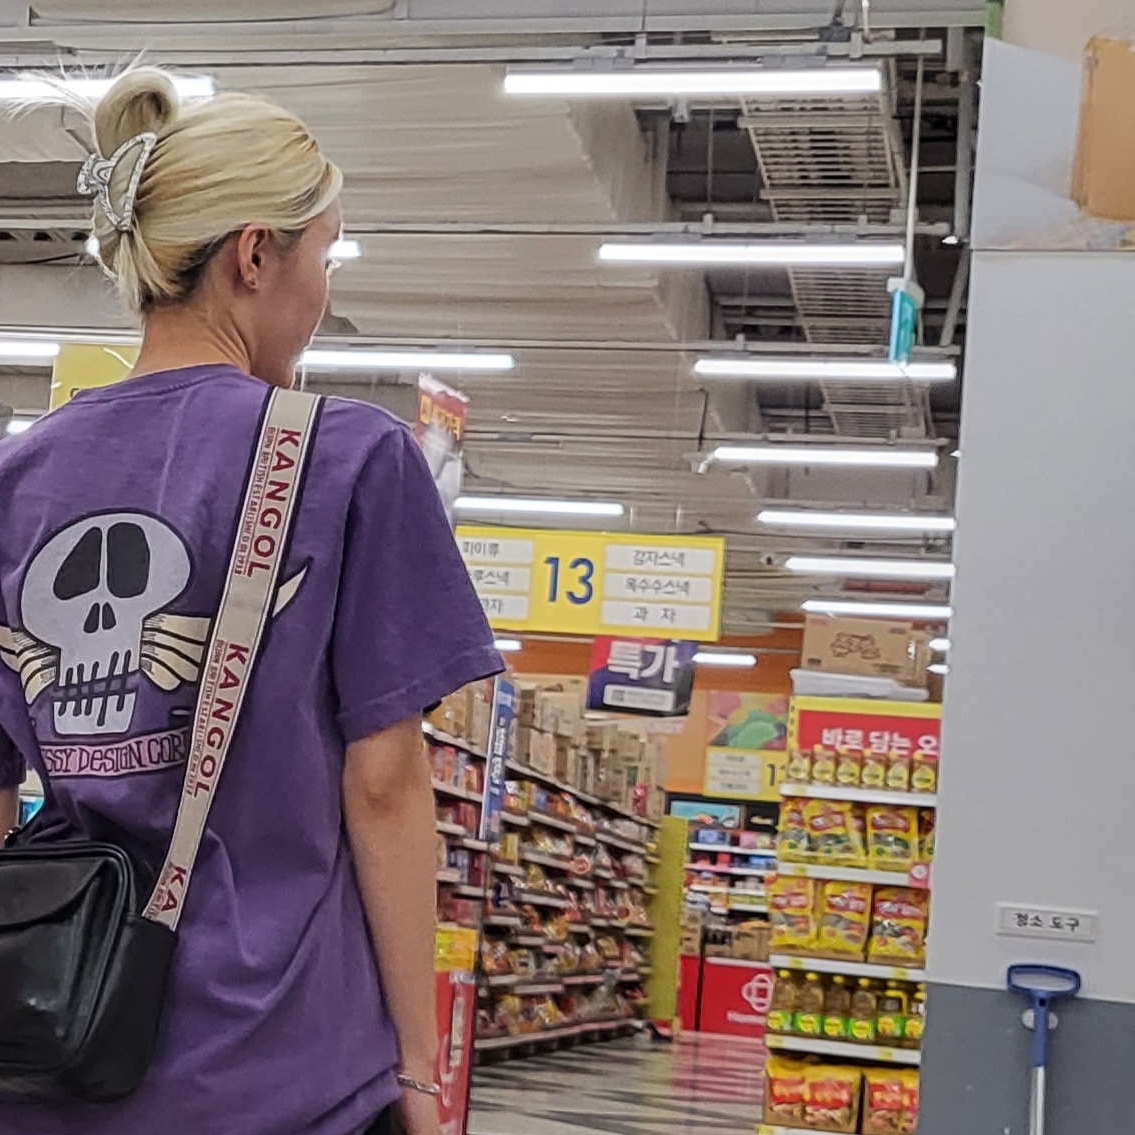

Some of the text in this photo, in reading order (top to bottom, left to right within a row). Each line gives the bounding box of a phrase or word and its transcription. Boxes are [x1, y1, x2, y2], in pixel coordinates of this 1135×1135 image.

[247, 427, 302, 578] KANGOL
[544, 556, 595, 605] 13
[607, 641, 681, 683] 특가
[193, 643, 249, 798] KANGOL
[822, 727, 863, 751] 바로
[869, 730, 912, 753] 담는
[42, 748, 76, 773] SSY
